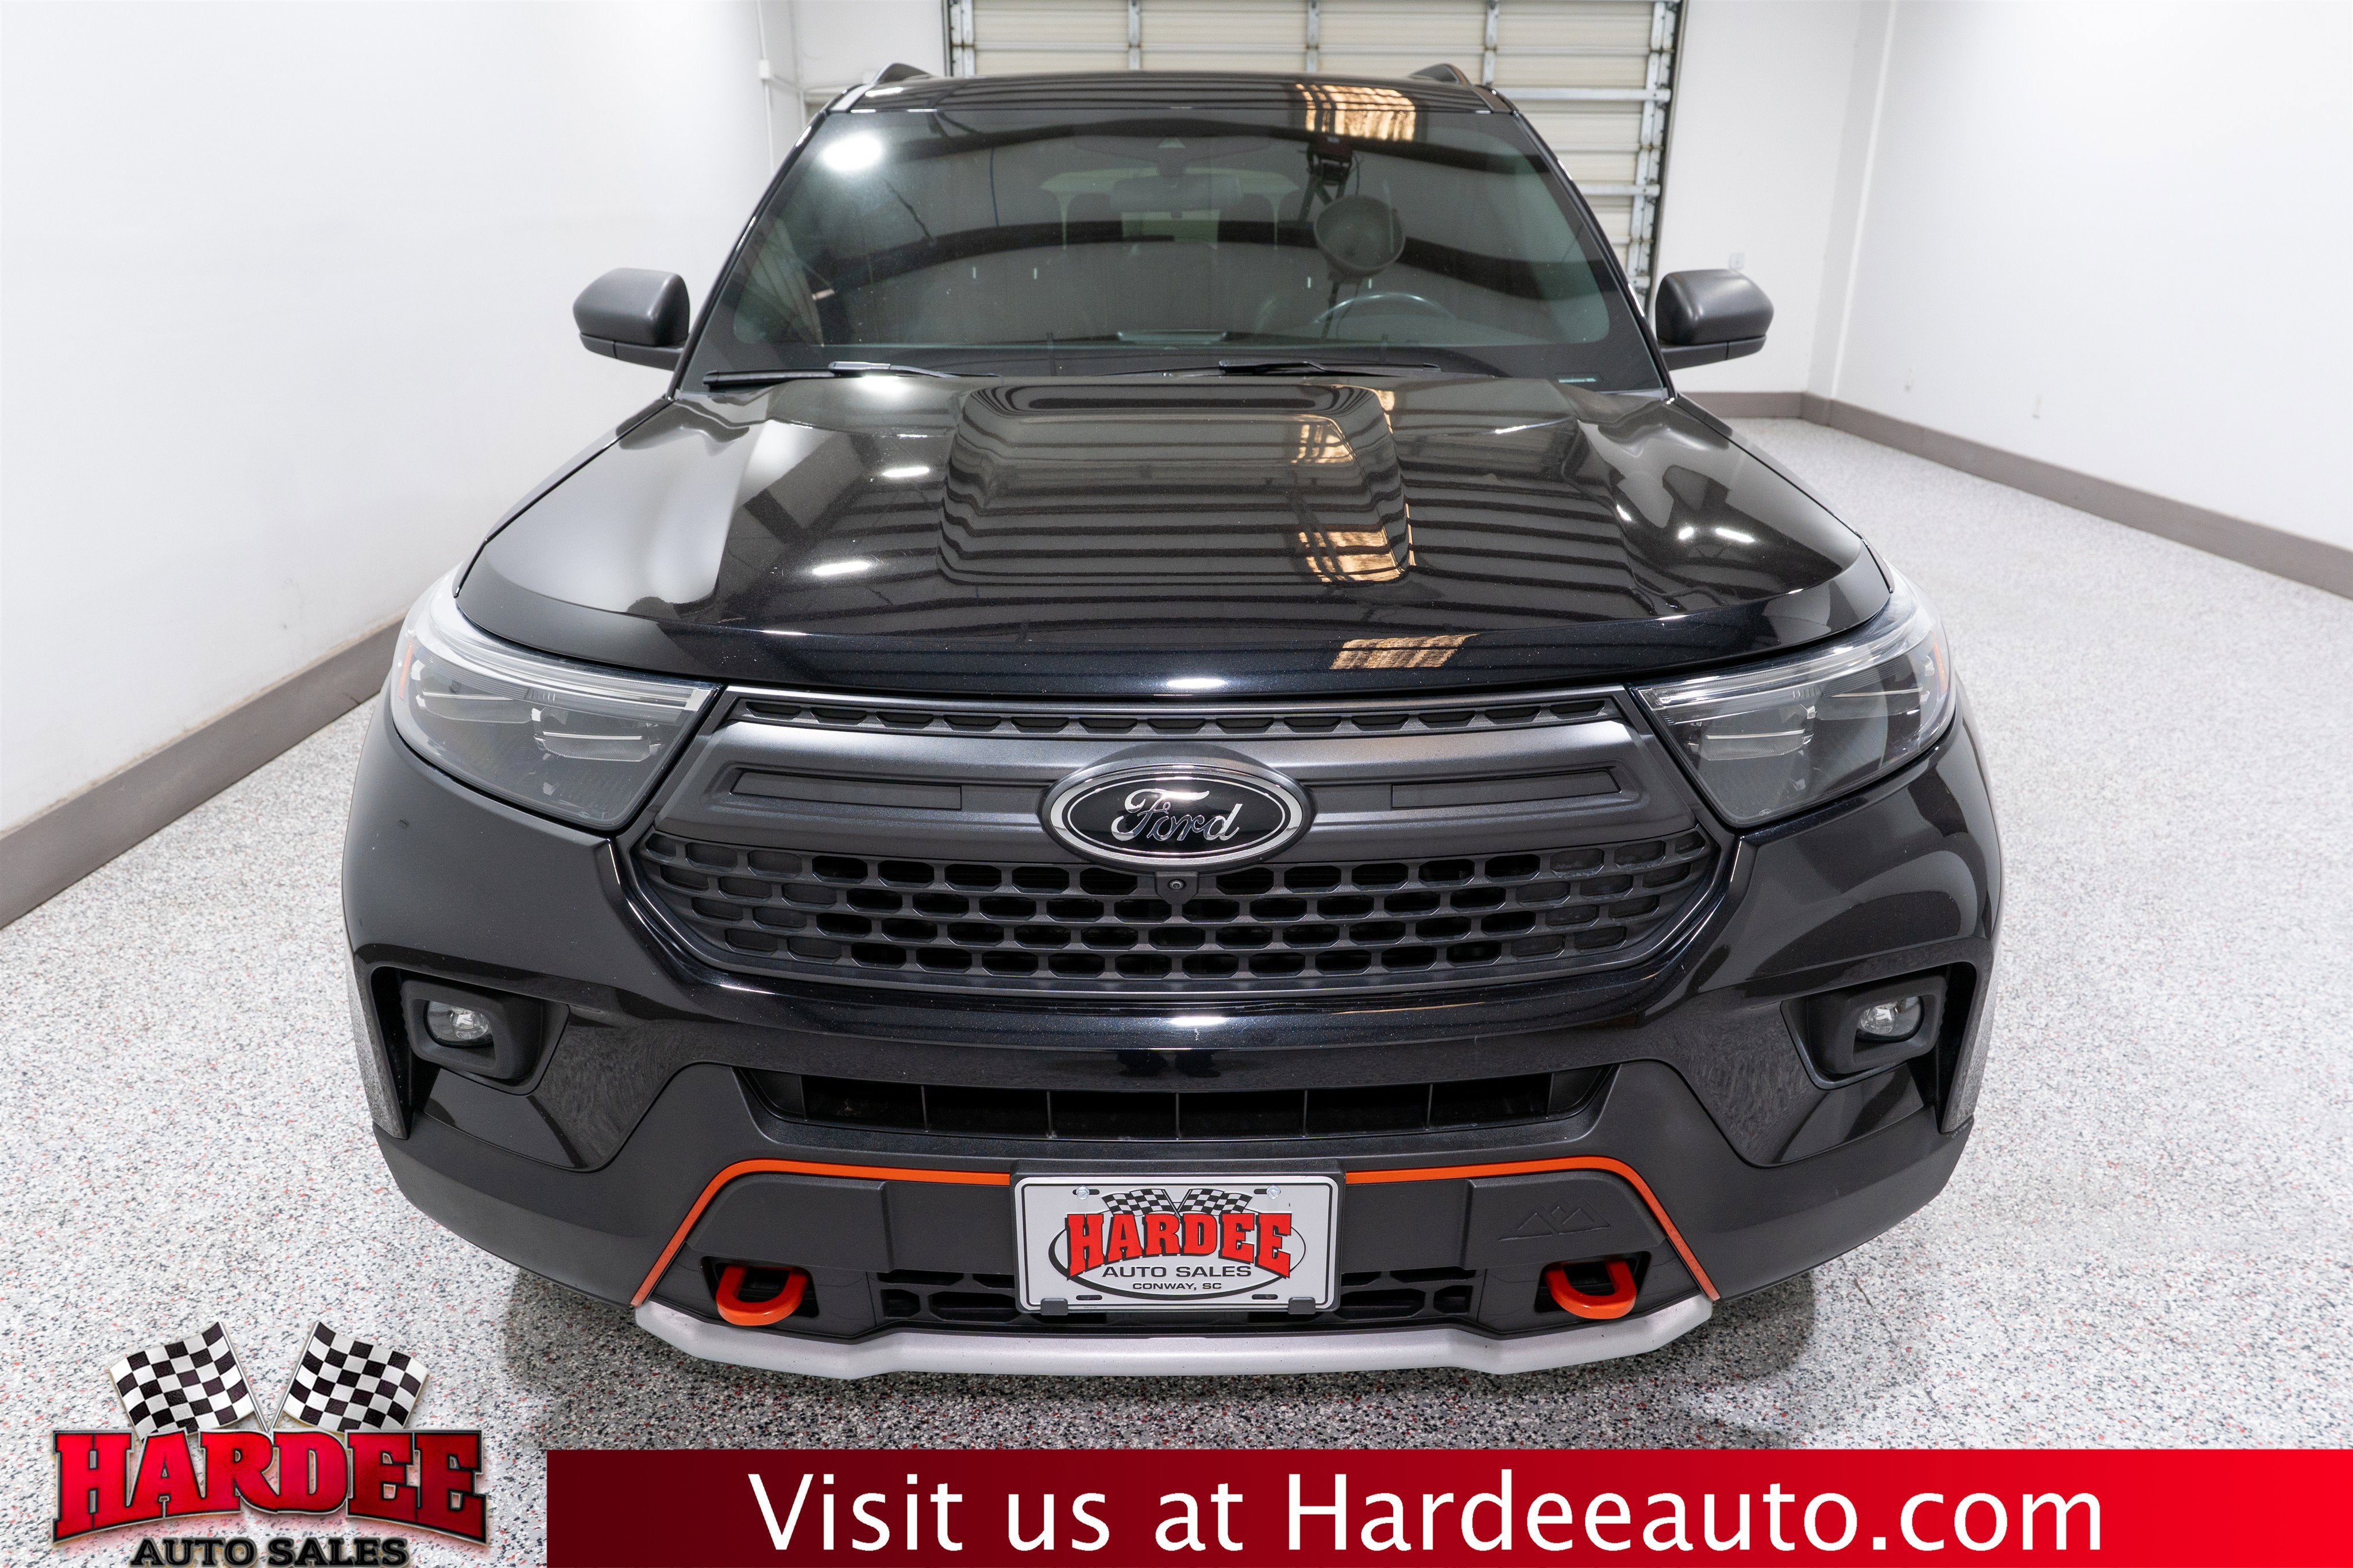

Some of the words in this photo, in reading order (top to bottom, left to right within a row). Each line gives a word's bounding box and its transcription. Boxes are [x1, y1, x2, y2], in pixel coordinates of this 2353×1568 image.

[1111, 788, 1243, 841] Ford
[1065, 1212, 1292, 1280] HARDEE
[1102, 1266, 1167, 1277] AUTO
[1175, 1265, 1252, 1277] SALES
[1132, 1282, 1197, 1291] CONWAY,
